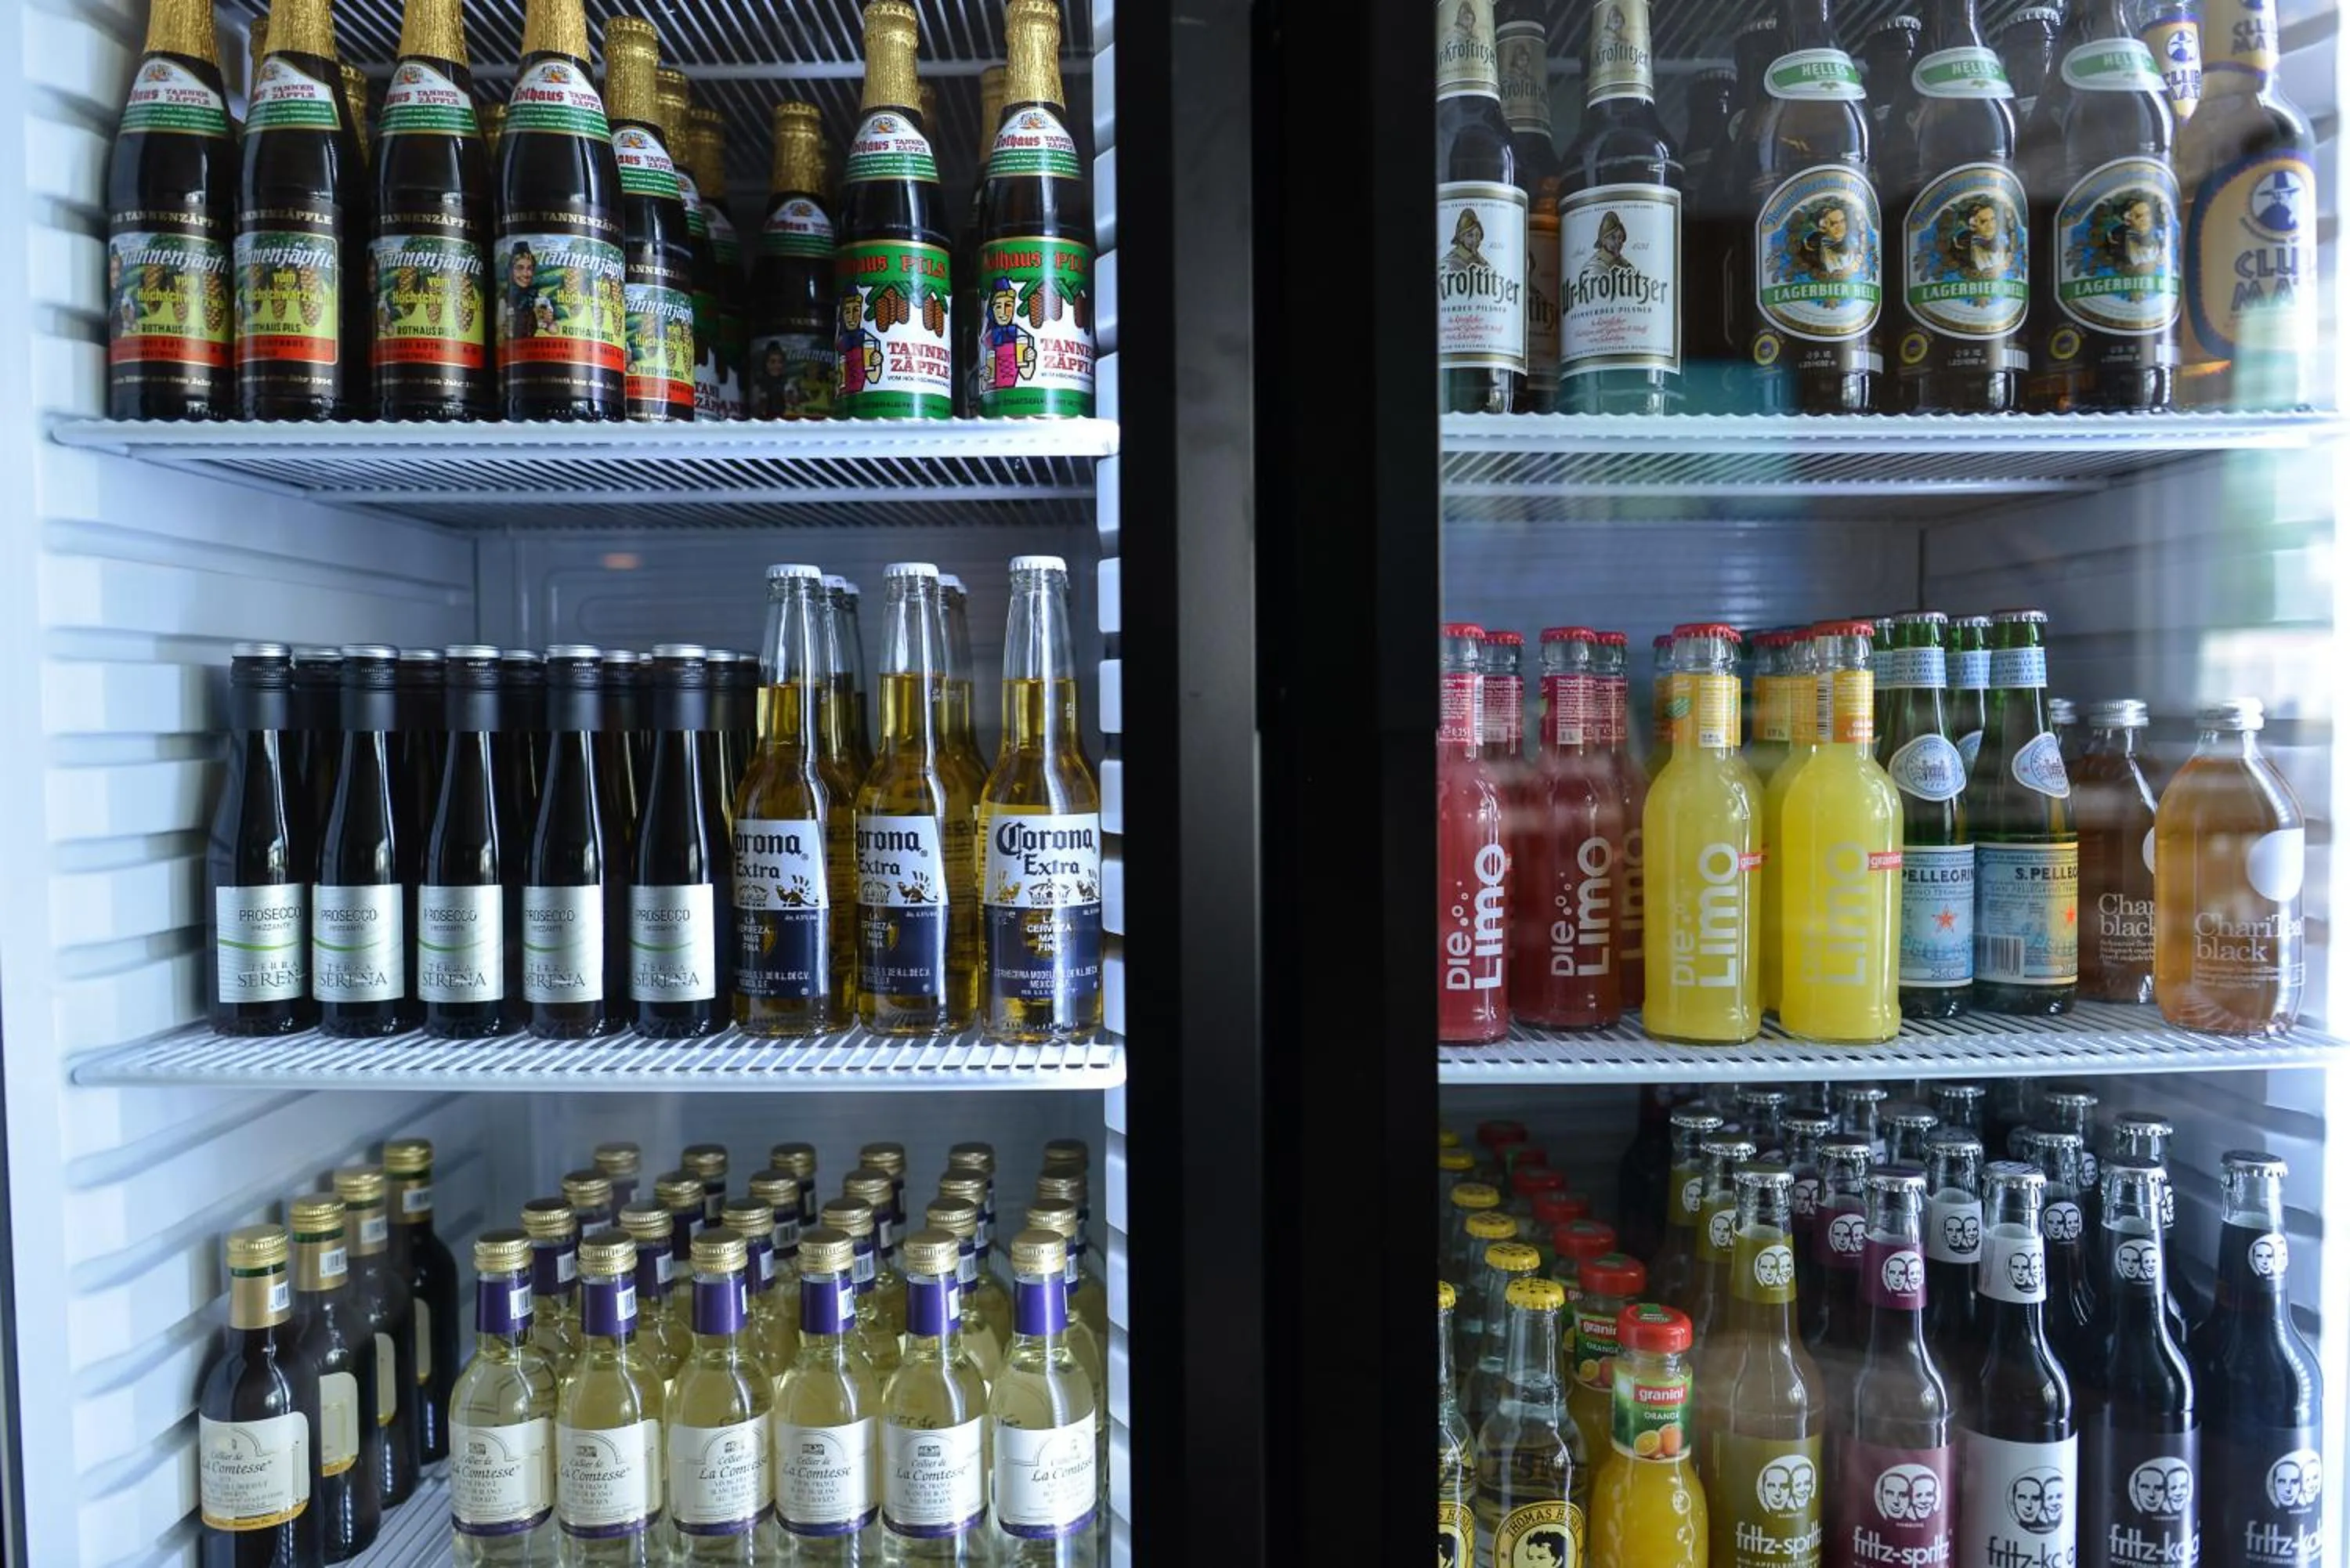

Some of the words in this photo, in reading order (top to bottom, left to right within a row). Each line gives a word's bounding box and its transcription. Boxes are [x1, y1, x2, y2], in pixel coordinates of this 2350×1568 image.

[1802, 61, 1848, 78] HELLES
[2233, 246, 2301, 280] CLU
[1773, 283, 1849, 302] LAGERBIER
[1922, 282, 1998, 302] LAGERBIER
[886, 341, 950, 363] TANNEN
[1039, 337, 1093, 359] TANNE
[1043, 352, 1094, 377] ZÄPFL
[733, 832, 803, 855] orona
[856, 828, 923, 854] orona
[996, 822, 1095, 861] Corona
[736, 856, 781, 880] Extra
[1022, 852, 1081, 877] Extra
[239, 906, 302, 922] PROSECCO
[321, 906, 378, 922] PROSECCO
[424, 906, 477, 922] PROSECCO
[526, 909, 575, 923] PROSECCO
[635, 909, 691, 923] PROSECCO
[1473, 843, 1505, 990] Limo
[1577, 836, 1612, 977] Limo
[1697, 841, 1741, 988] Limo
[1825, 840, 1870, 986] Limo
[2196, 935, 2269, 963] black
[1582, 1321, 1617, 1335] granin
[1639, 1388, 1685, 1403] granini
[1644, 1411, 1679, 1422] ORANGE
[571, 1468, 627, 1483] Comtesse
[797, 1465, 852, 1480] Comtesse
[1505, 1508, 1553, 1537] THOMAS
[1853, 1526, 1950, 1568] fritz-spritz
